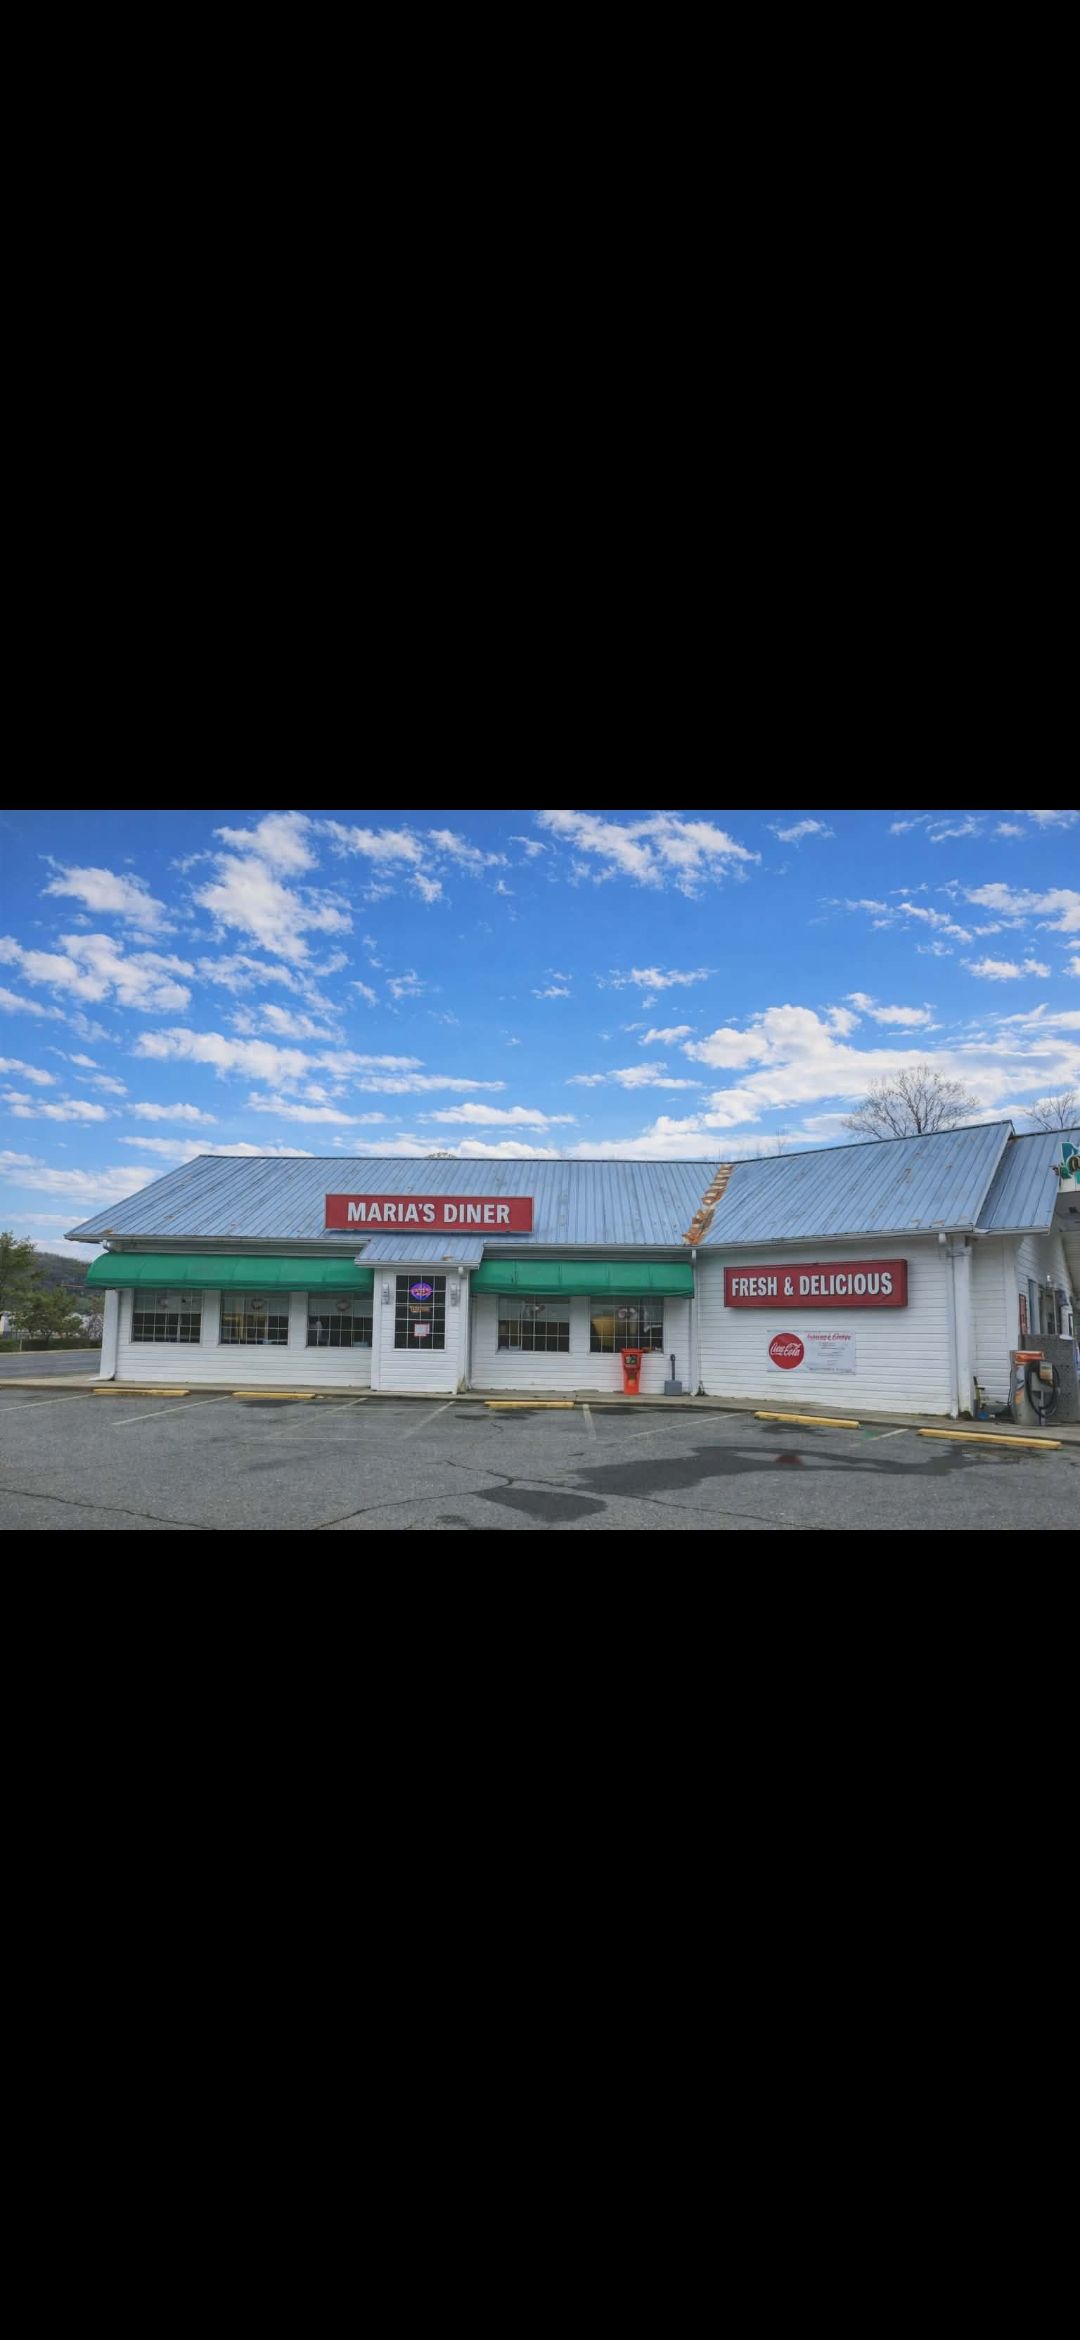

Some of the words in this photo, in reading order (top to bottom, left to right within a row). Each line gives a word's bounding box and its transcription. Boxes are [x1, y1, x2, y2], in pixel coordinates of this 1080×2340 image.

[347, 1202, 435, 1223] MARIA'S
[443, 1203, 511, 1224] DINER
[731, 1276, 778, 1297] FRESH
[783, 1276, 794, 1297] &
[800, 1272, 893, 1296] DELICIOUS
